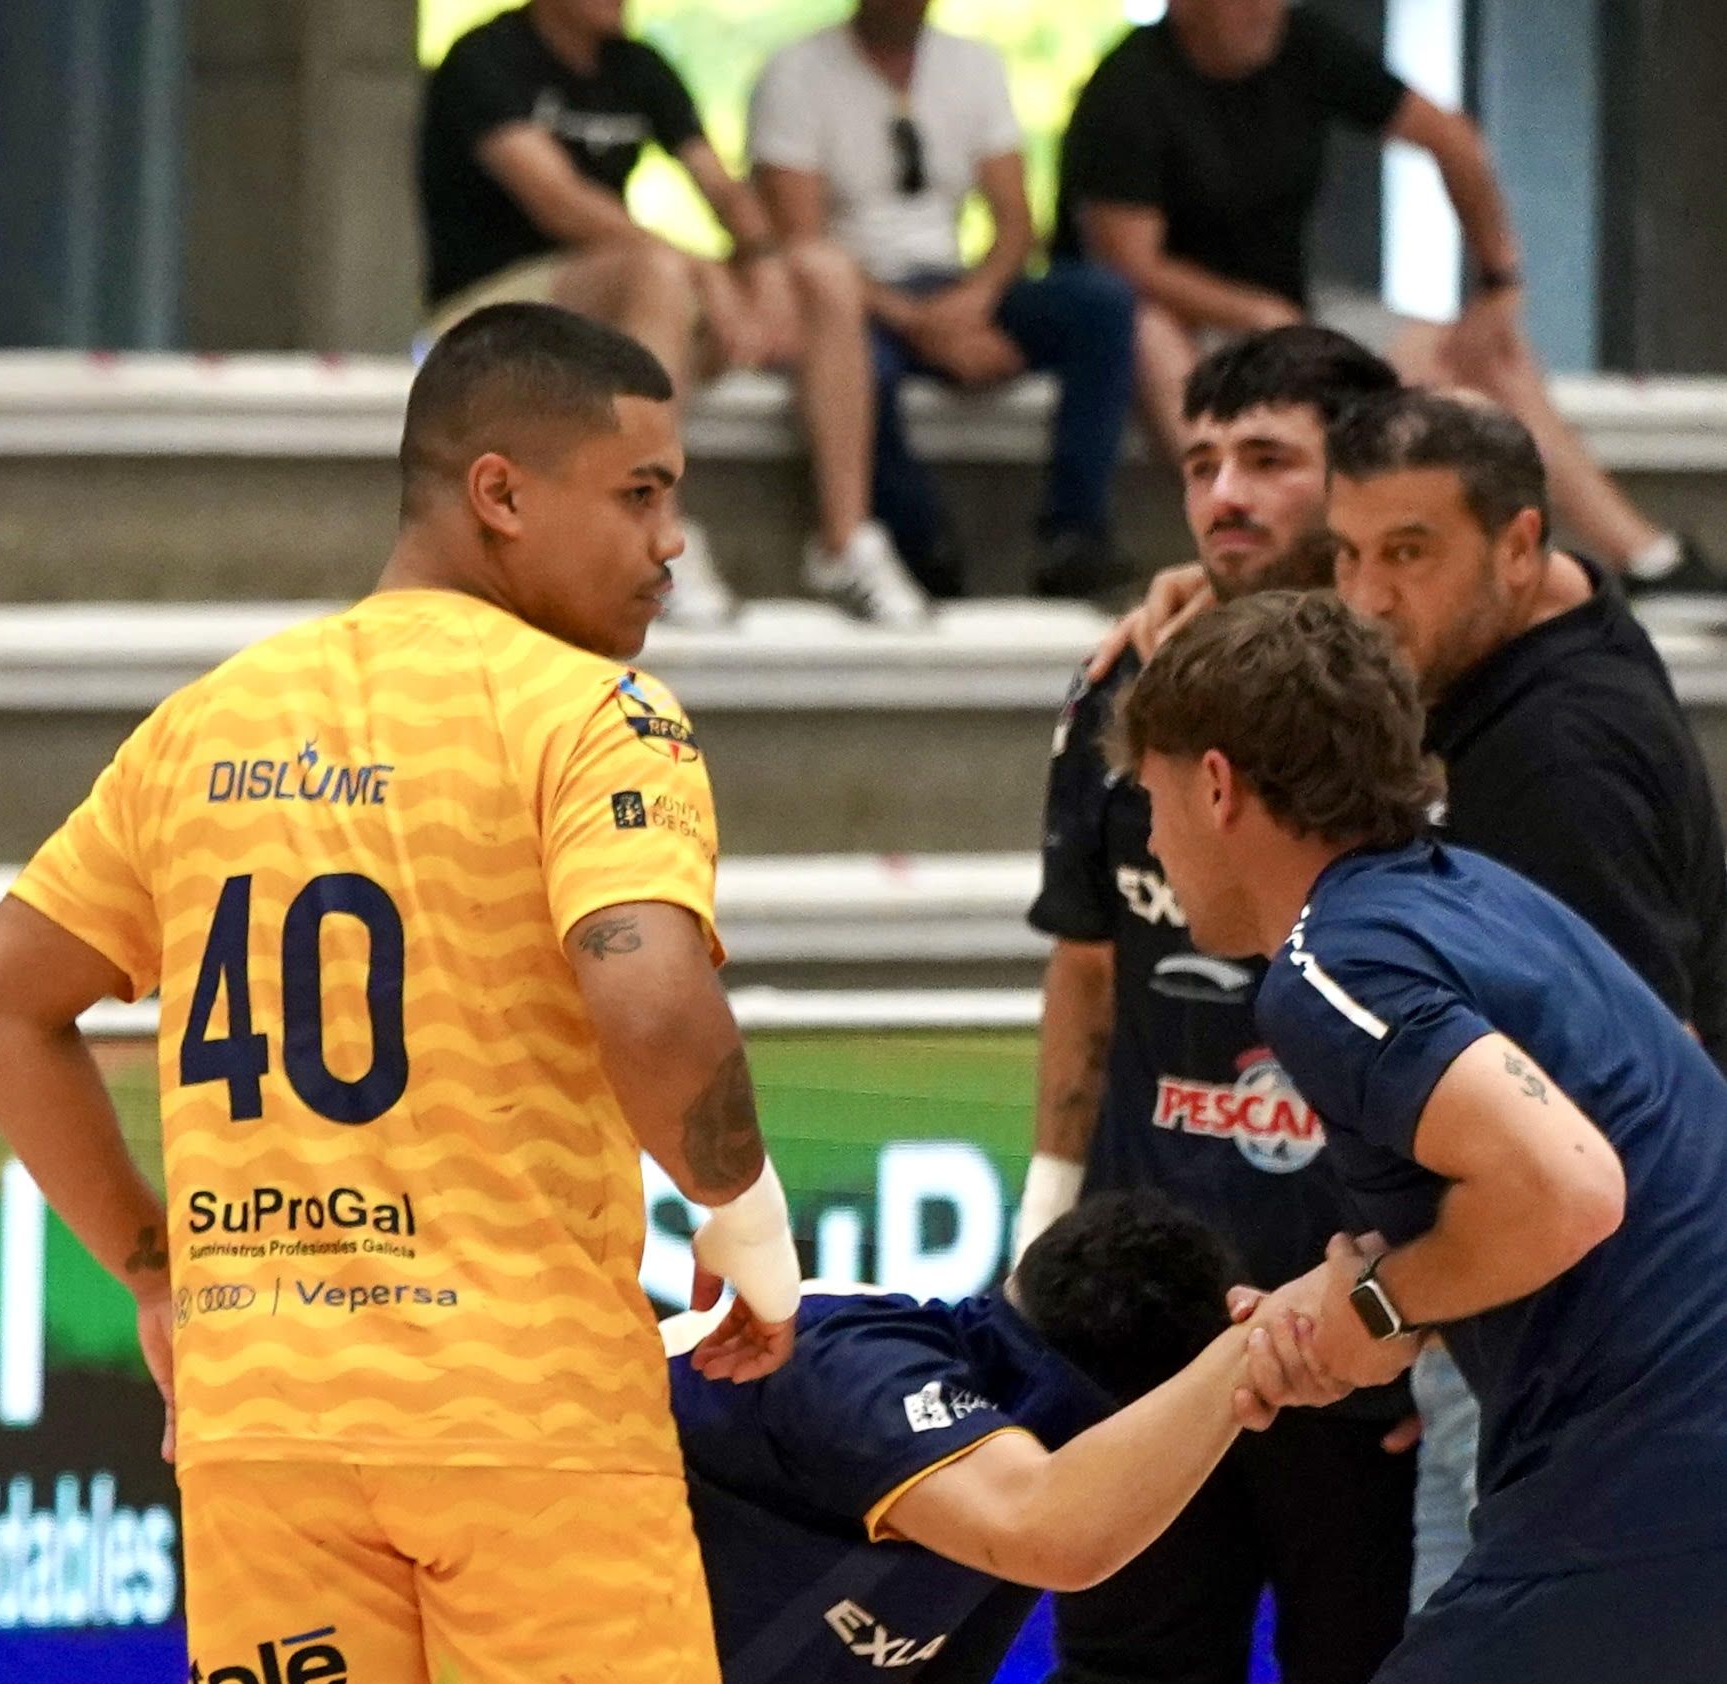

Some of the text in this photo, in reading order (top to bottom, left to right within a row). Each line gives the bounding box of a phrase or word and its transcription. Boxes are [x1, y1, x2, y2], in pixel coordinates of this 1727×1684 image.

[179, 873, 409, 1126] 40
[189, 1187, 416, 1237] SuProGal
[296, 1279, 458, 1313] Vepersa
